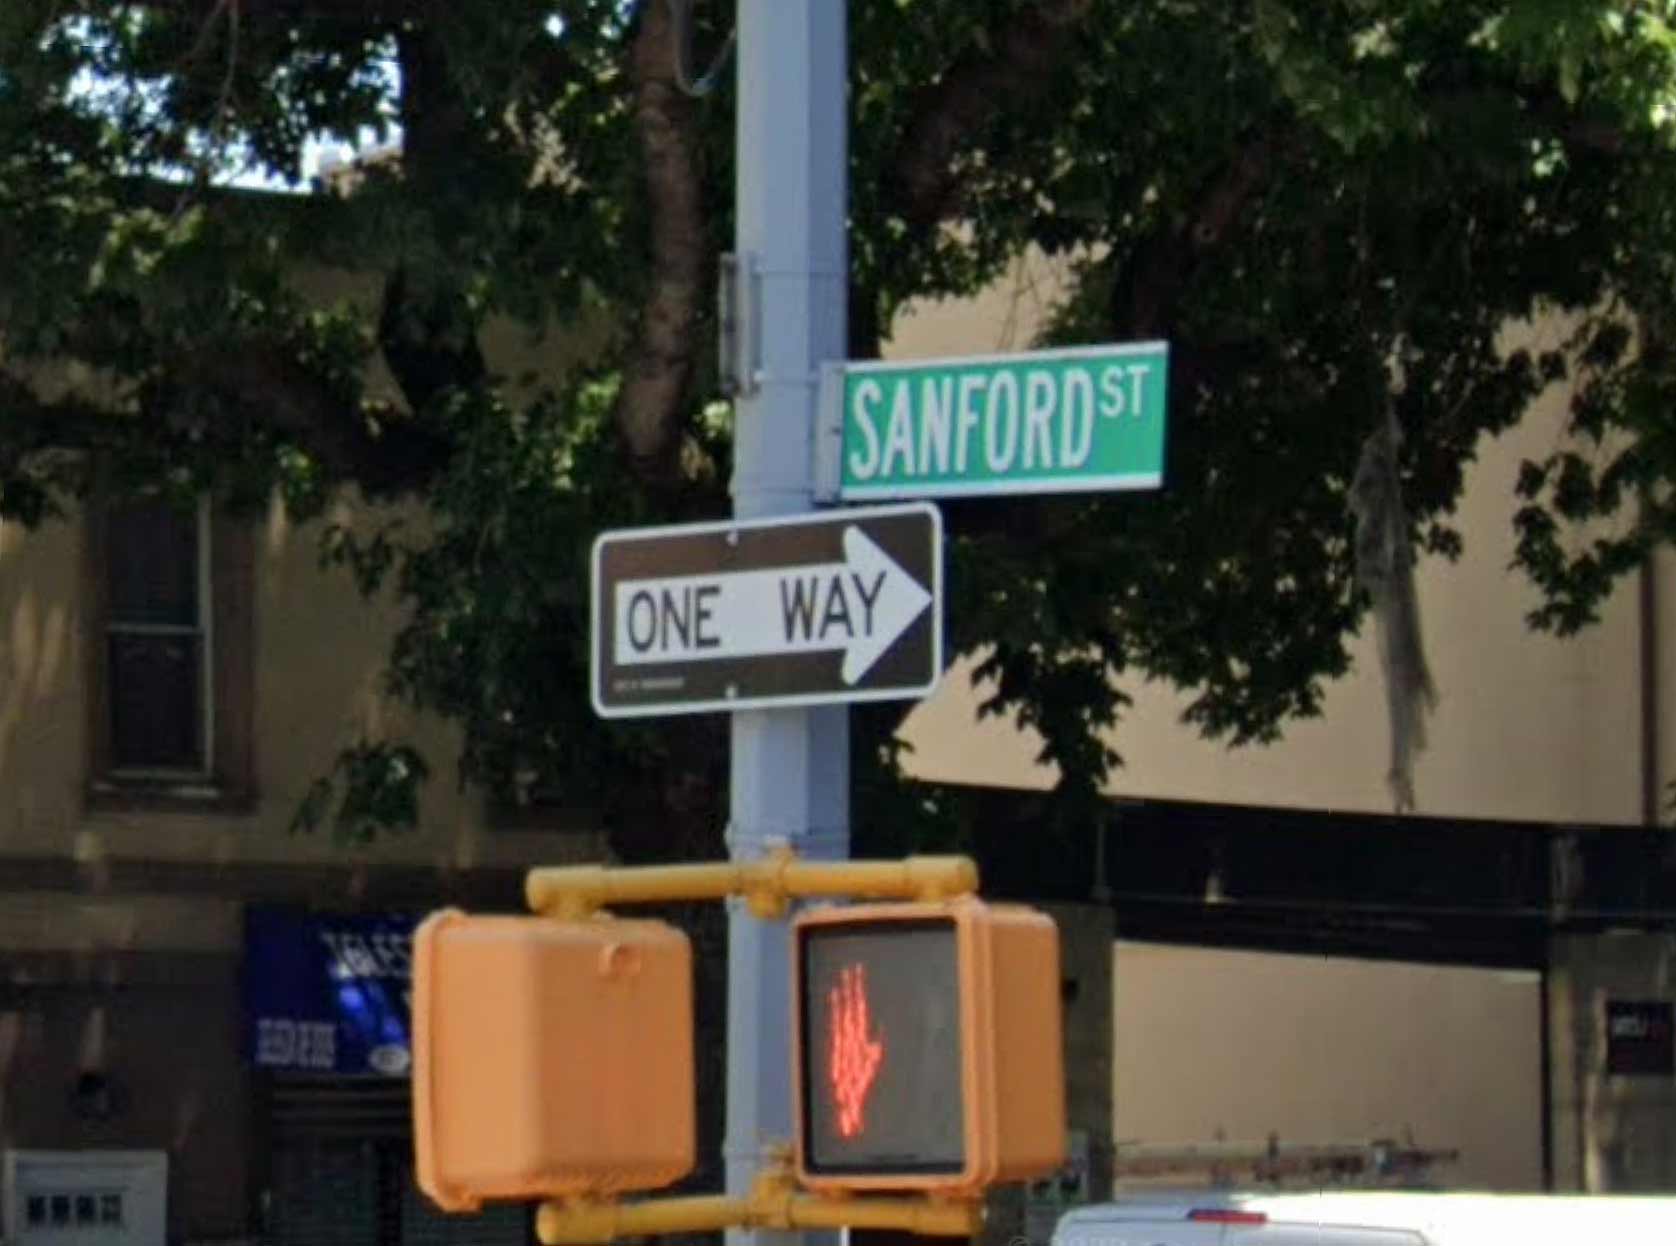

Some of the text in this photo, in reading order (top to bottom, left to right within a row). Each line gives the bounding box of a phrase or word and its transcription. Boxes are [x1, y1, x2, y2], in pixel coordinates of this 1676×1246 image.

[849, 365, 1150, 480] SANFORD ST
[627, 572, 887, 652] ONE WAY
